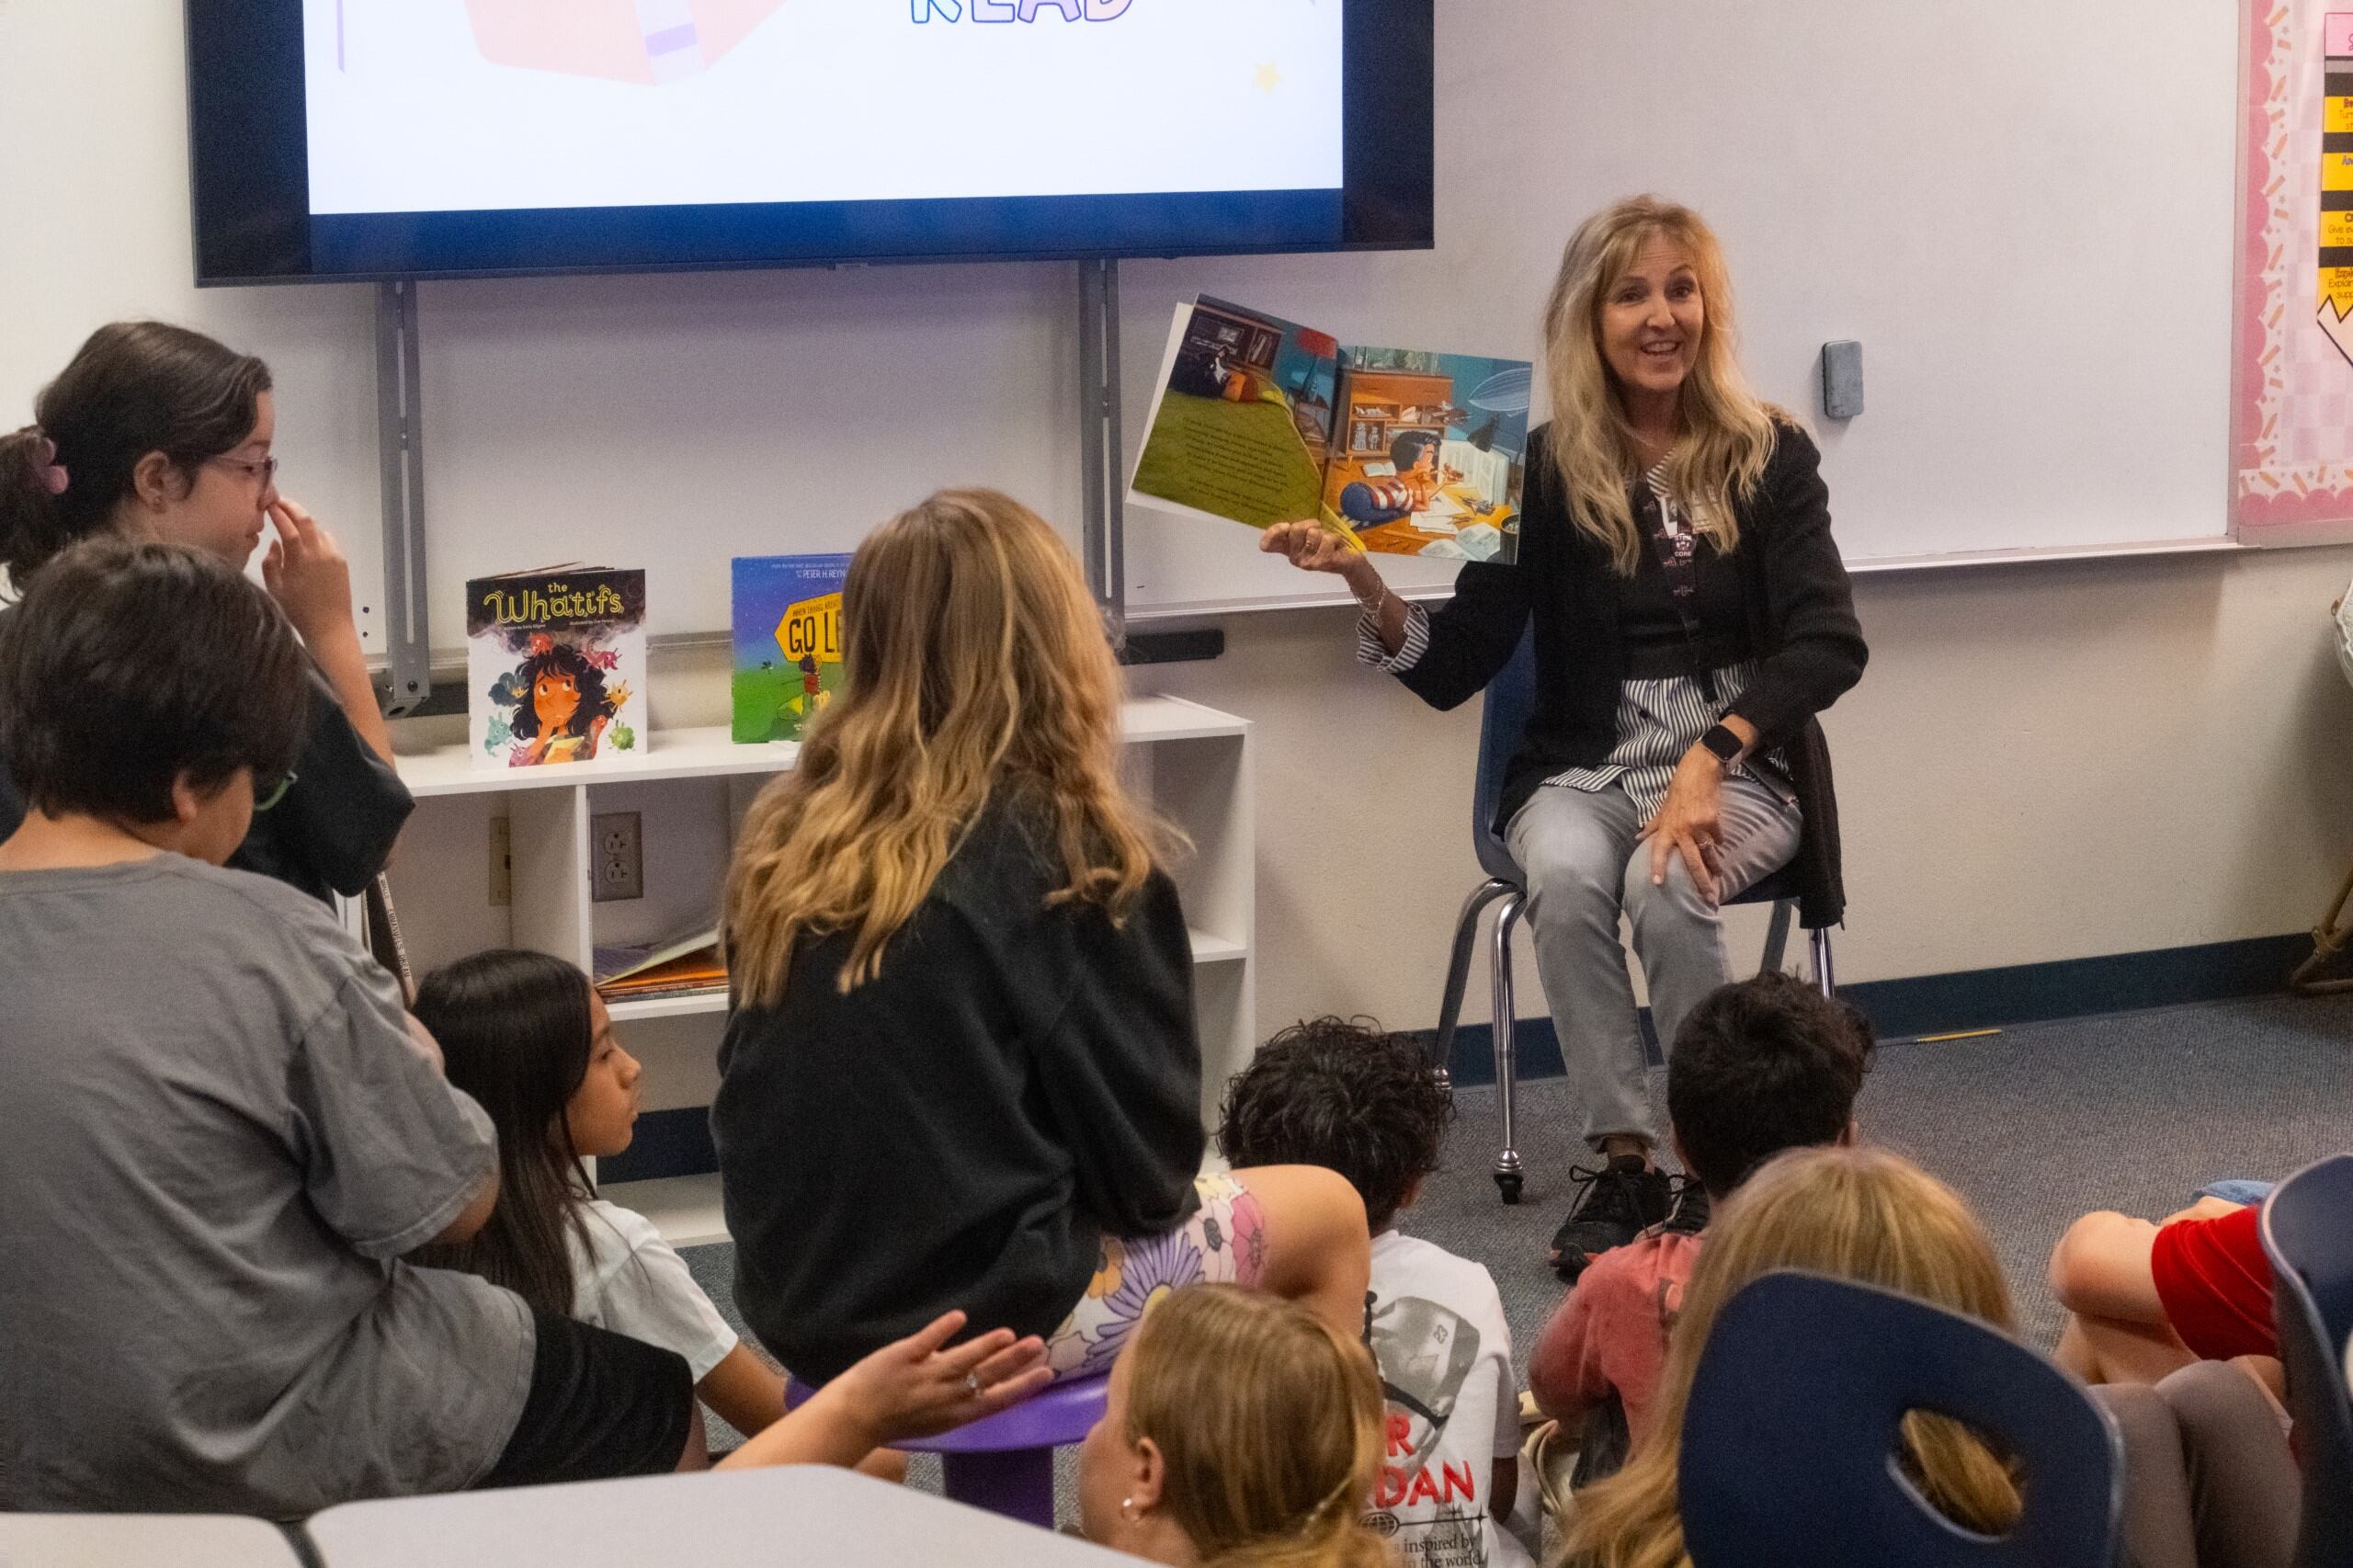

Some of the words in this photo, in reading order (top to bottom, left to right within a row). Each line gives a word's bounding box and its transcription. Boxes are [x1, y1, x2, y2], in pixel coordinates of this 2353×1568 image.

[802, 569, 821, 579] PETER
[548, 582, 568, 594] the
[483, 586, 622, 624] Whatifs
[789, 616, 816, 654] GO
[824, 609, 843, 653] LE
[1375, 1460, 1475, 1509] DAN
[1404, 1533, 1457, 1553] inspired
[1461, 1533, 1476, 1553] by
[1420, 1554, 1442, 1568] the
